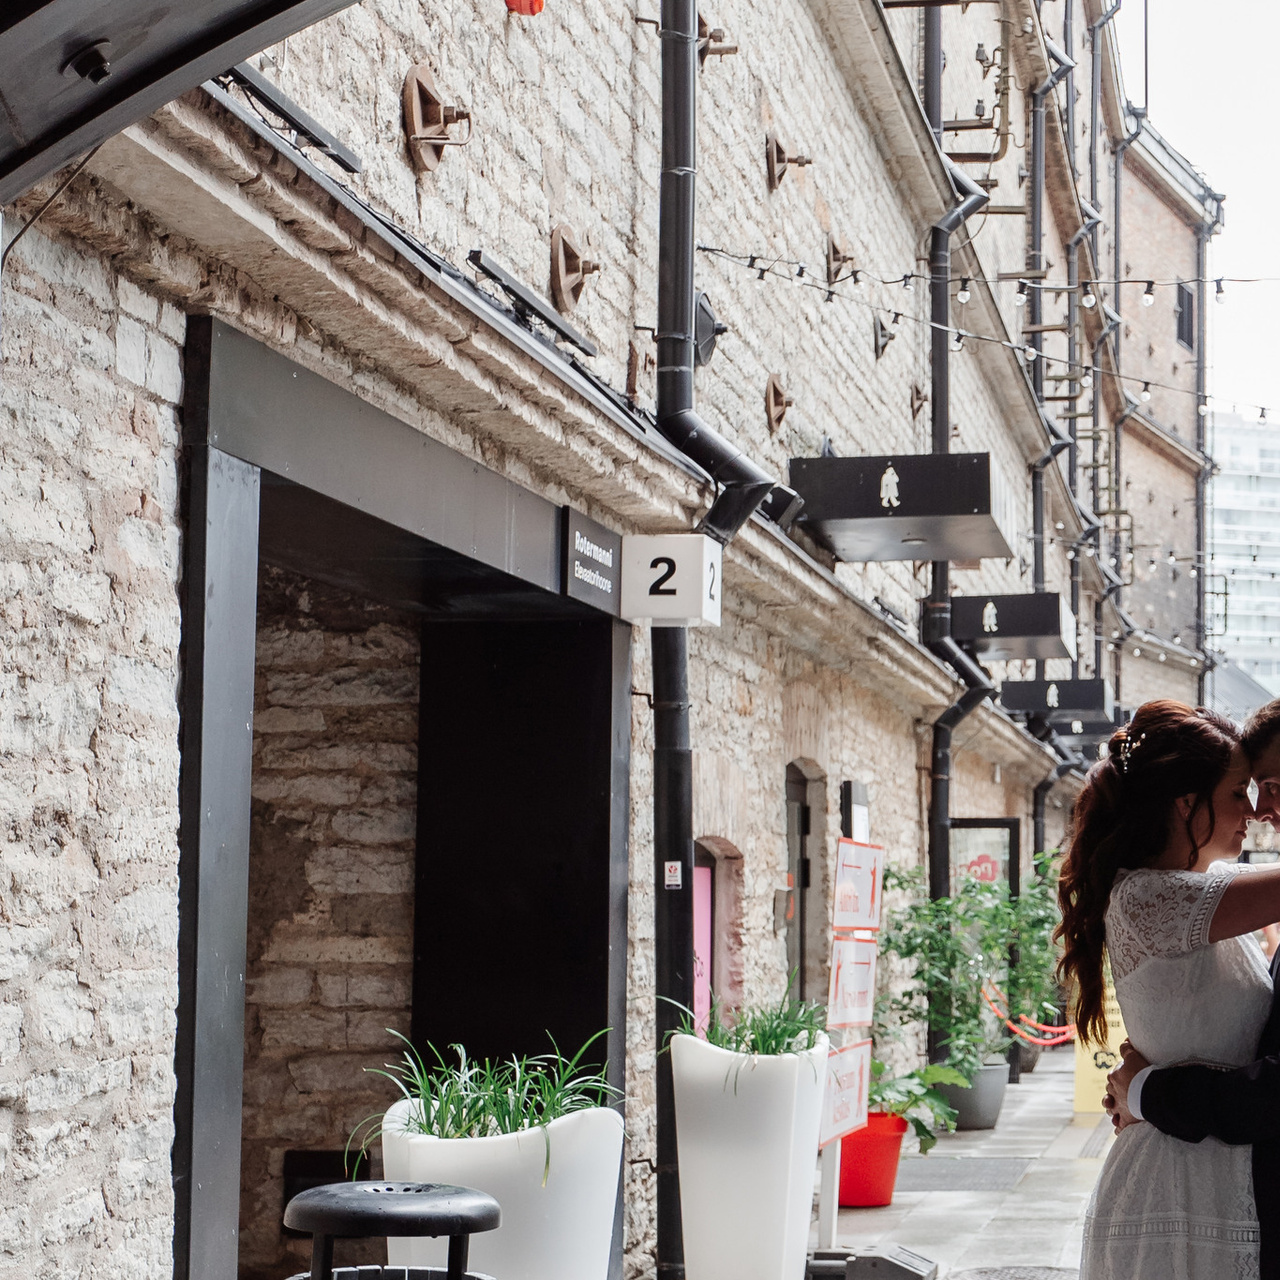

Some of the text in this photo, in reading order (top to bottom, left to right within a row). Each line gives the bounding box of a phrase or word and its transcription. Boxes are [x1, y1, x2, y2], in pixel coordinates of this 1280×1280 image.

[574, 530, 613, 568] Rotermanni
[648, 556, 677, 596] 2
[708, 562, 716, 601] 2
